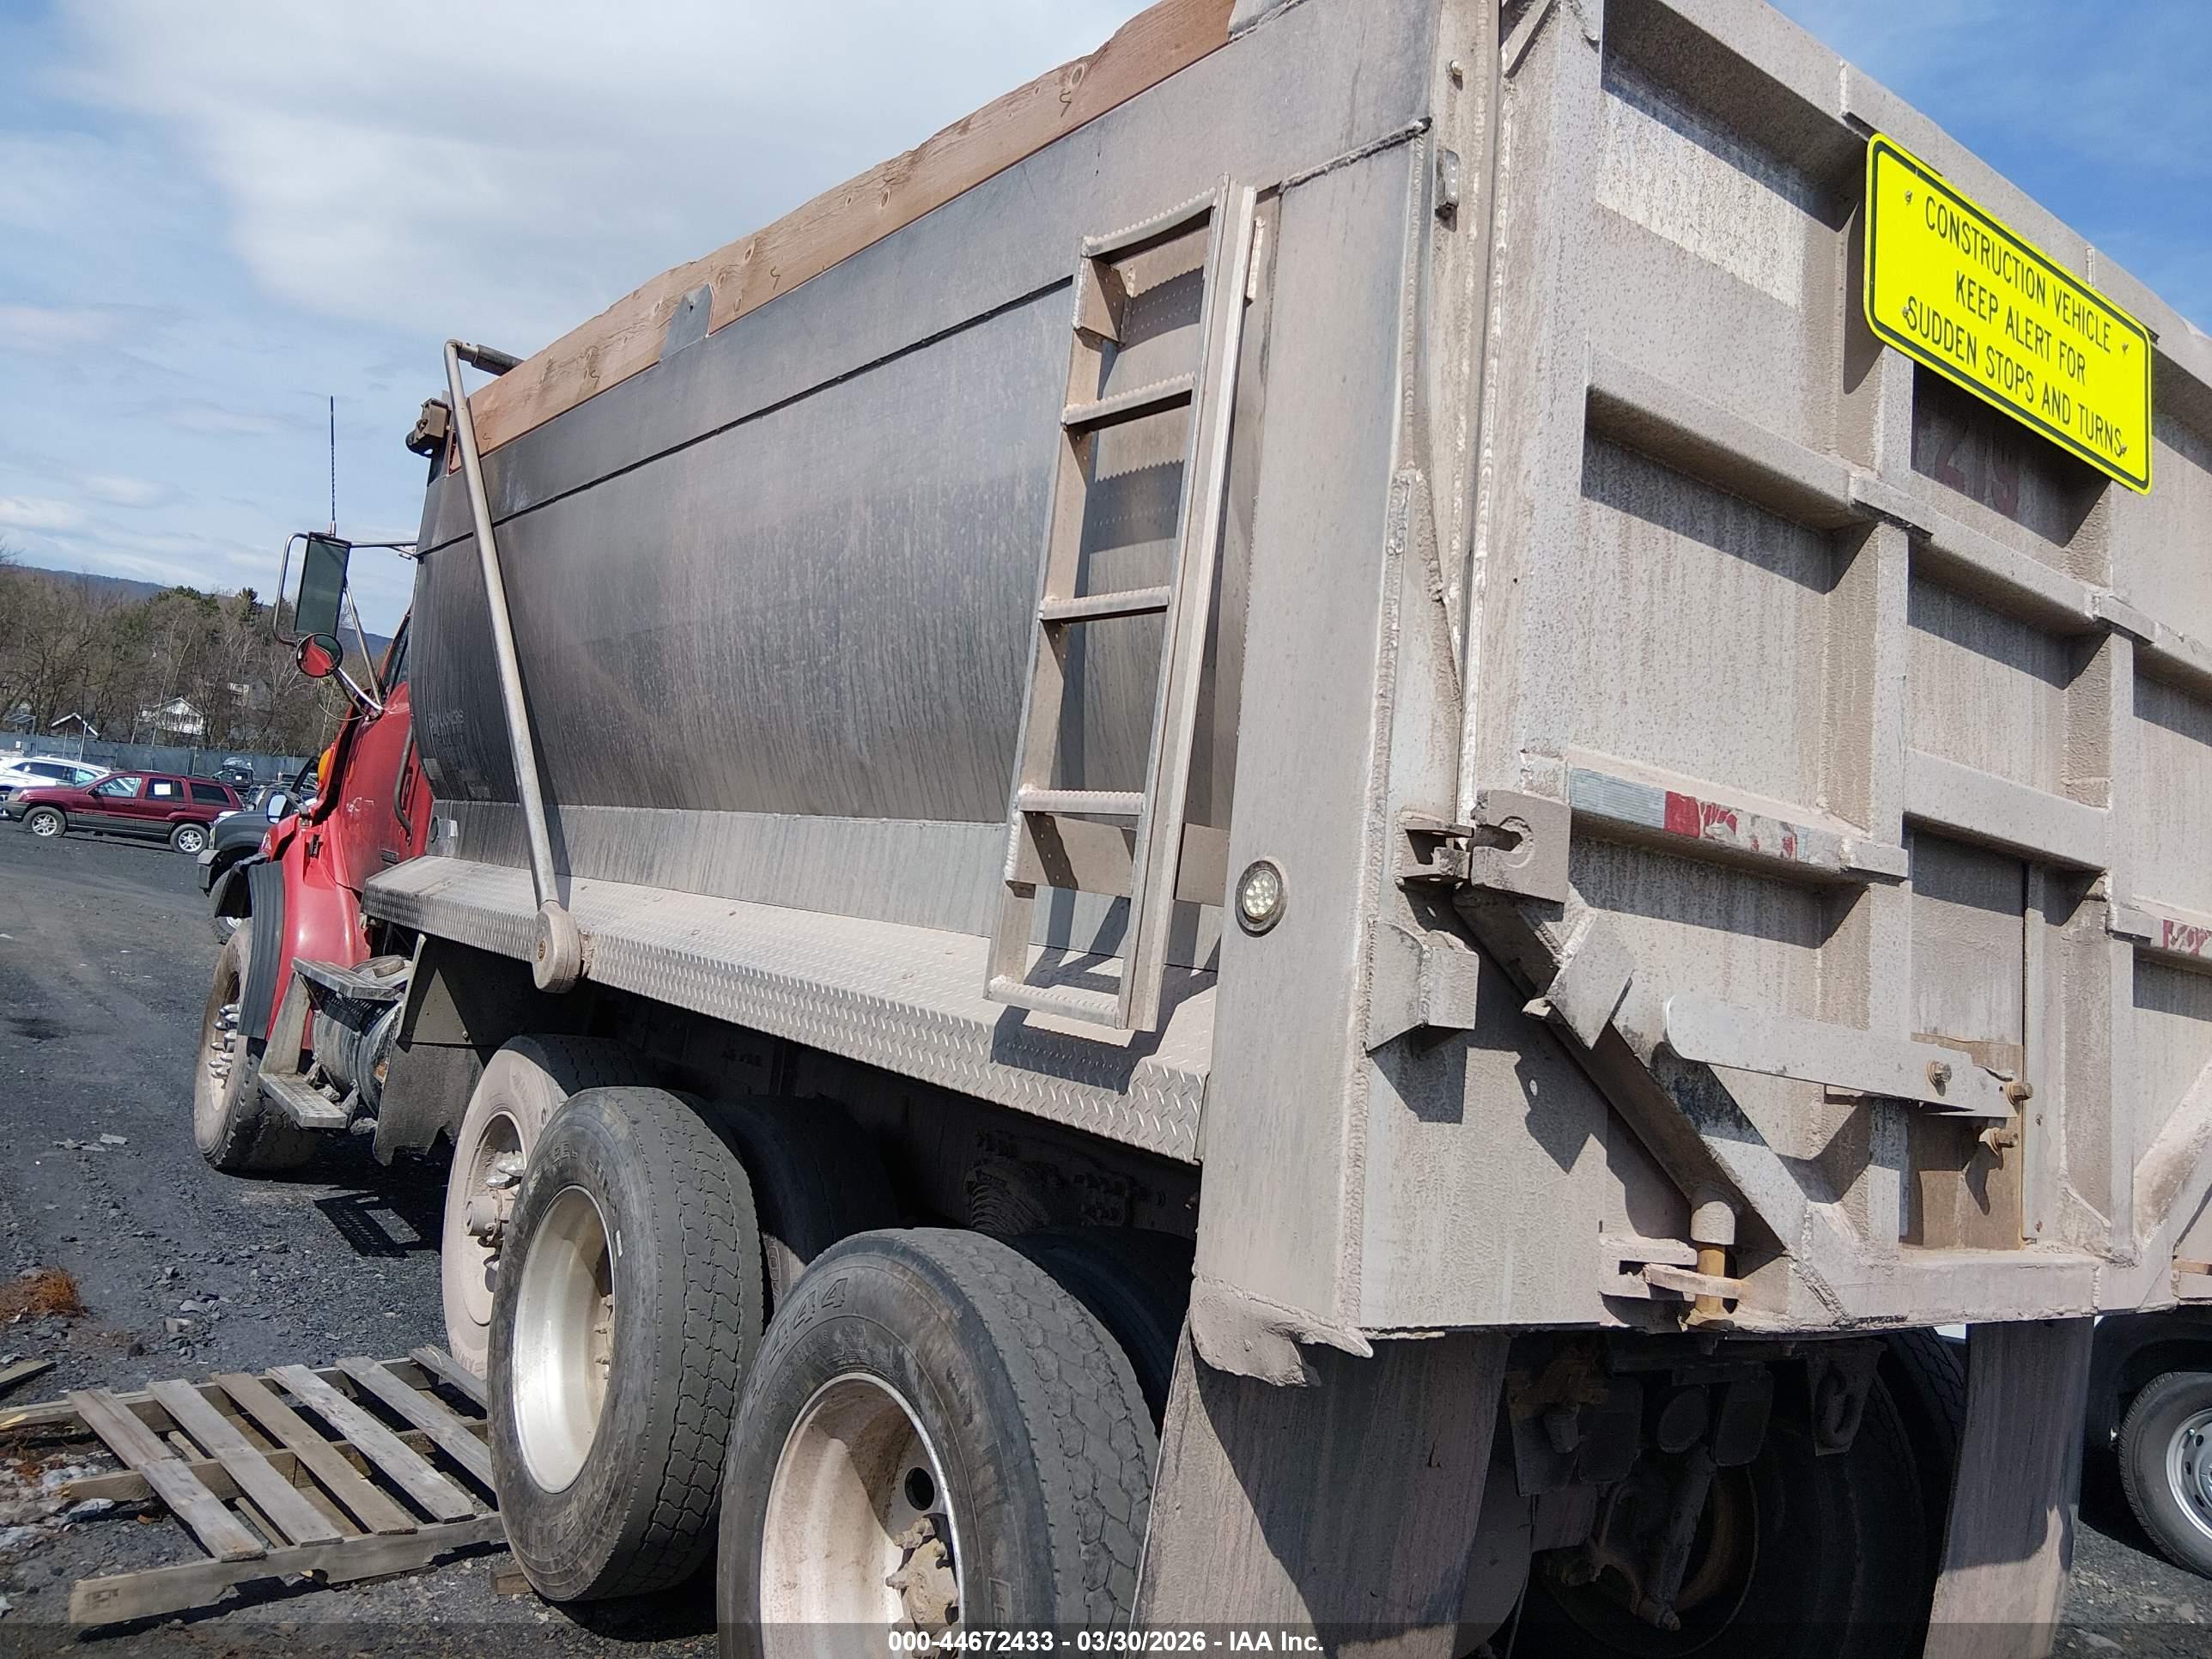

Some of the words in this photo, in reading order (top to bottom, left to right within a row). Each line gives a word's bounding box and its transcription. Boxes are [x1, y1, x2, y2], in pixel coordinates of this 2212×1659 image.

[1925, 196, 2045, 307] CONSTRUCTION
[2053, 284, 2111, 354] VEHICLE
[1956, 270, 1999, 324] KEEP
[2005, 306, 2051, 363] ALERT
[2059, 343, 2087, 386] FOR
[1906, 296, 1977, 369] SUDDEN
[1986, 349, 2034, 404] STOPS
[2042, 382, 2071, 426] AND
[2078, 403, 2123, 458] TURNS
